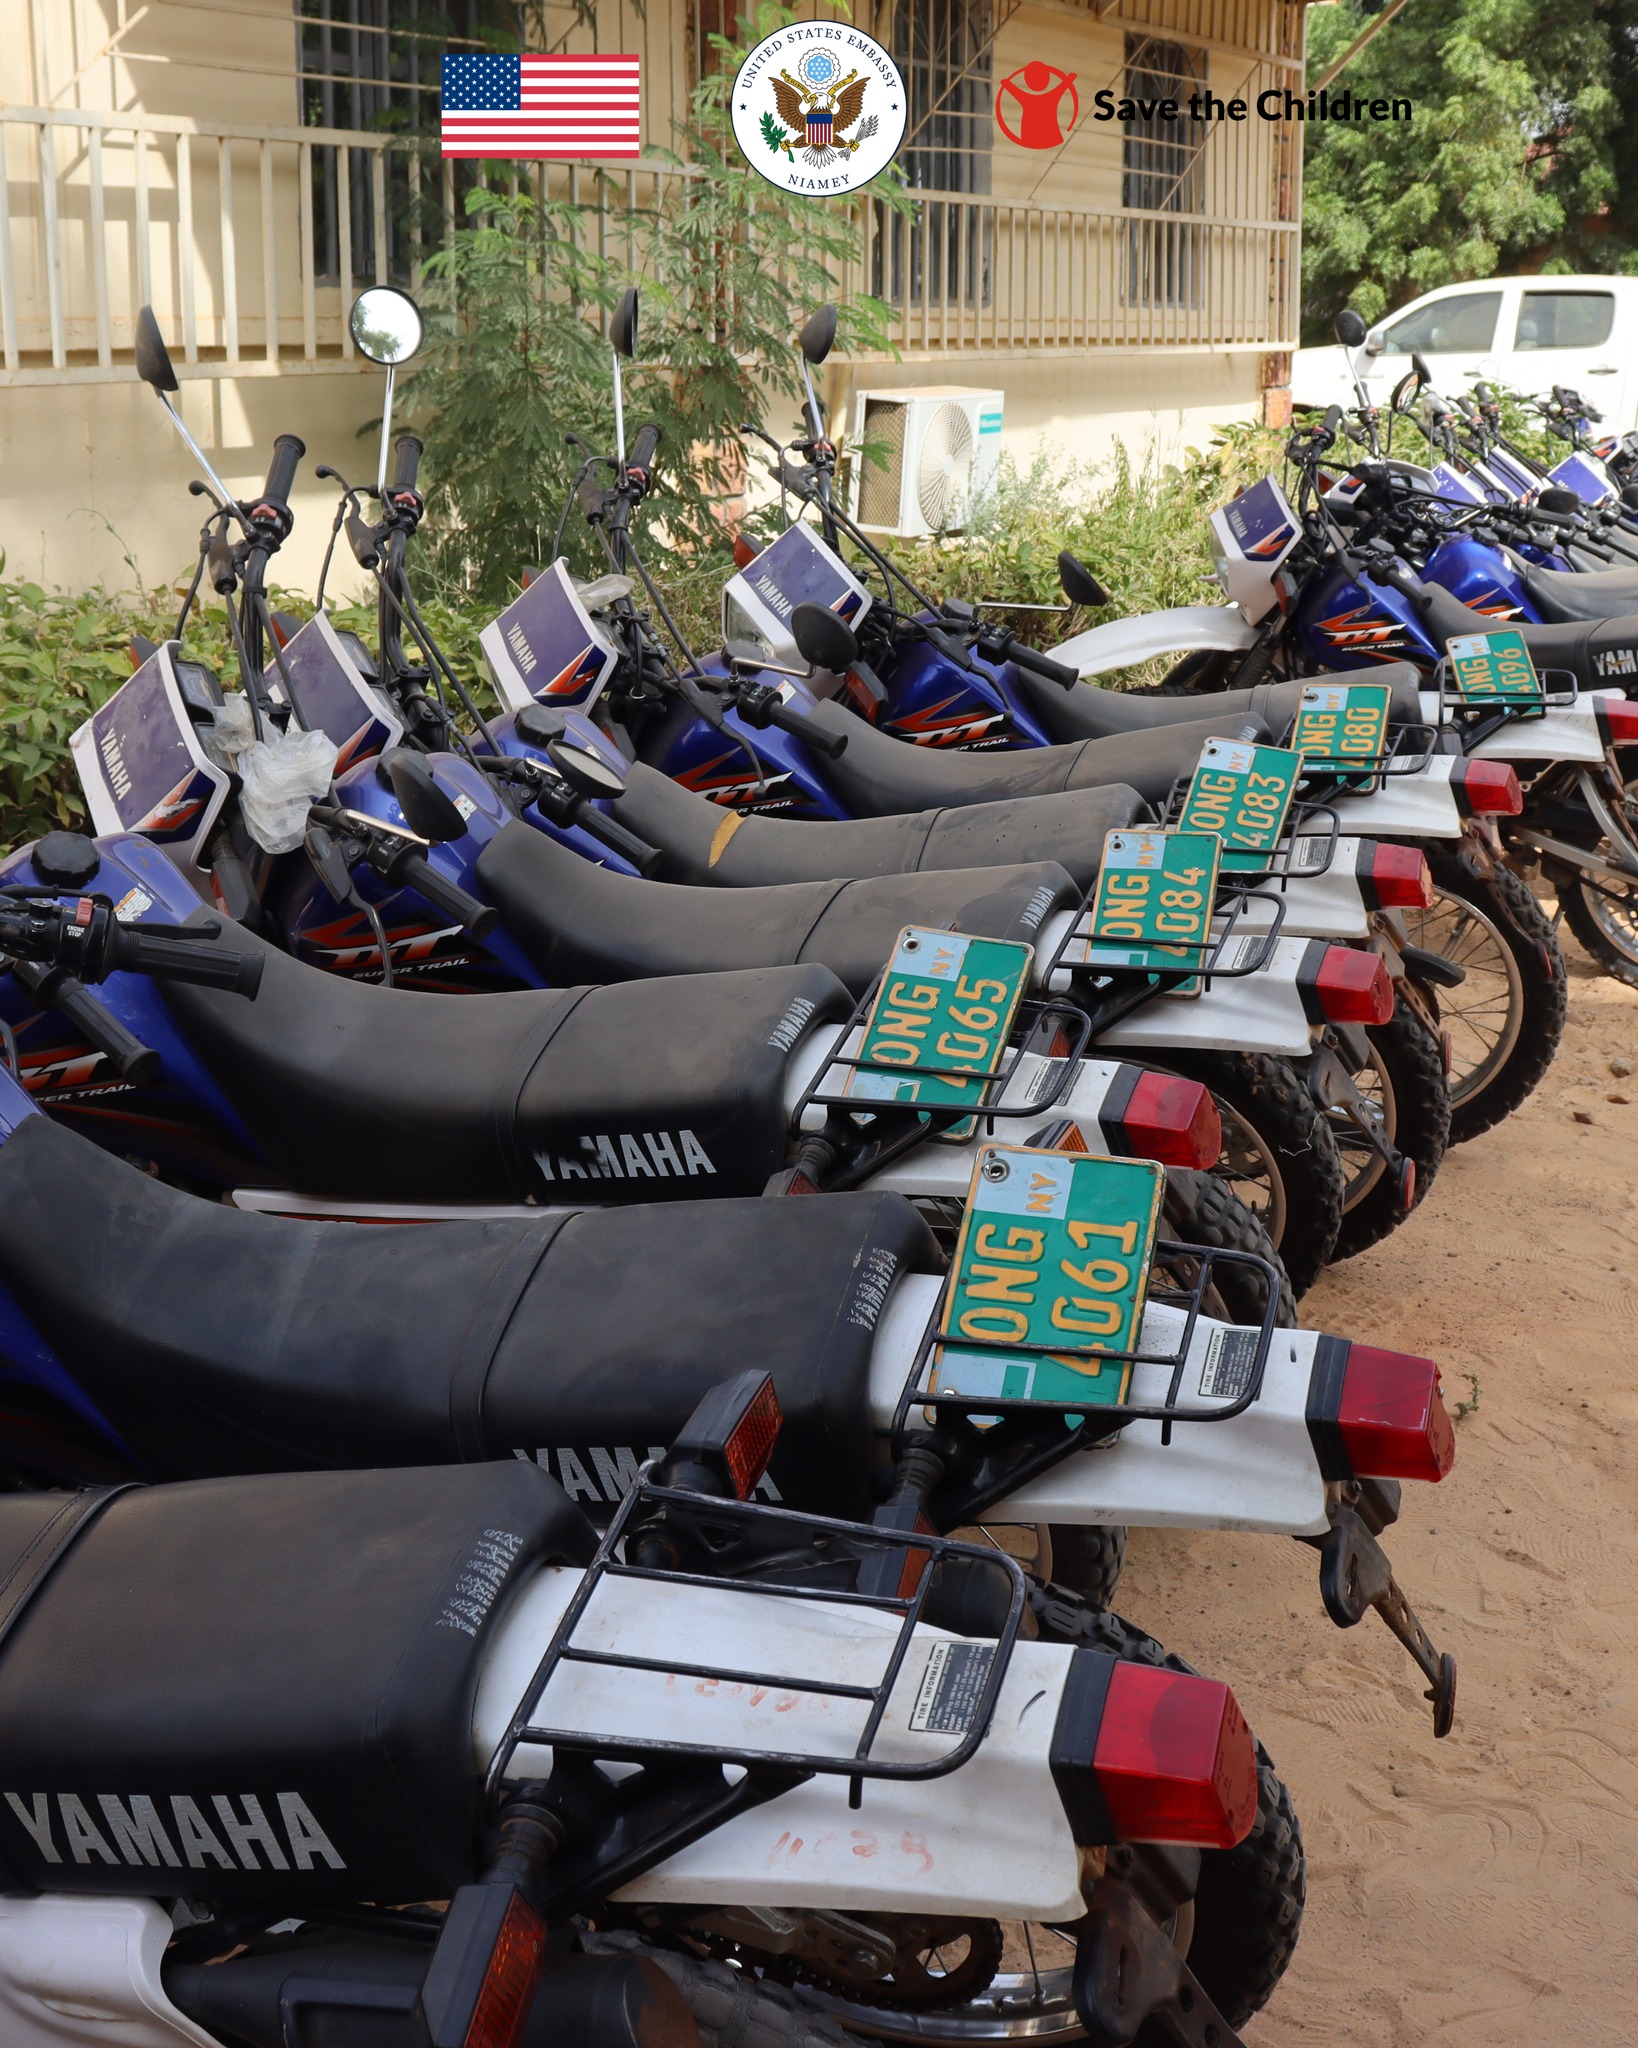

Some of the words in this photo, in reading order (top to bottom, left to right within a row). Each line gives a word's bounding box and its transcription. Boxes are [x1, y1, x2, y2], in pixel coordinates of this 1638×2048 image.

[1228, 508, 1249, 540] YAMAHA
[755, 574, 794, 619] YAMAHA
[506, 621, 538, 675] YAMAHA
[1460, 657, 1497, 692] ONG
[1592, 649, 1638, 676] YAM
[972, 737, 1010, 749] TRAIL
[1299, 714, 1338, 757] ONG
[100, 727, 133, 801] YAMAHA
[1189, 773, 1238, 830] ONG
[1228, 751, 1246, 771] NY
[752, 799, 794, 812] TRAIL
[1231, 772, 1286, 848] 4083
[1019, 886, 1056, 930] YAMAHA
[1100, 874, 1151, 940] ONG
[1137, 842, 1157, 867] NY
[1152, 866, 1207, 958] 4084
[66, 924, 86, 934] ENGINE
[67, 930, 82, 938] STOP
[417, 957, 470, 971] TRAIL
[767, 997, 816, 1053] YAMAHA
[871, 981, 942, 1066] ONG
[929, 947, 955, 976] NY
[933, 975, 1008, 1089] 4065
[76, 1083, 137, 1099] TRAIL
[531, 1129, 718, 1182] YAMAHA
[959, 1223, 1047, 1342] ONG
[1026, 1172, 1057, 1212] NY
[1046, 1220, 1139, 1377] 4061
[918, 1702, 928, 1720] TIRE
[924, 1649, 945, 1698] INFORMATION
[3, 1791, 348, 1871] YAMAHA
